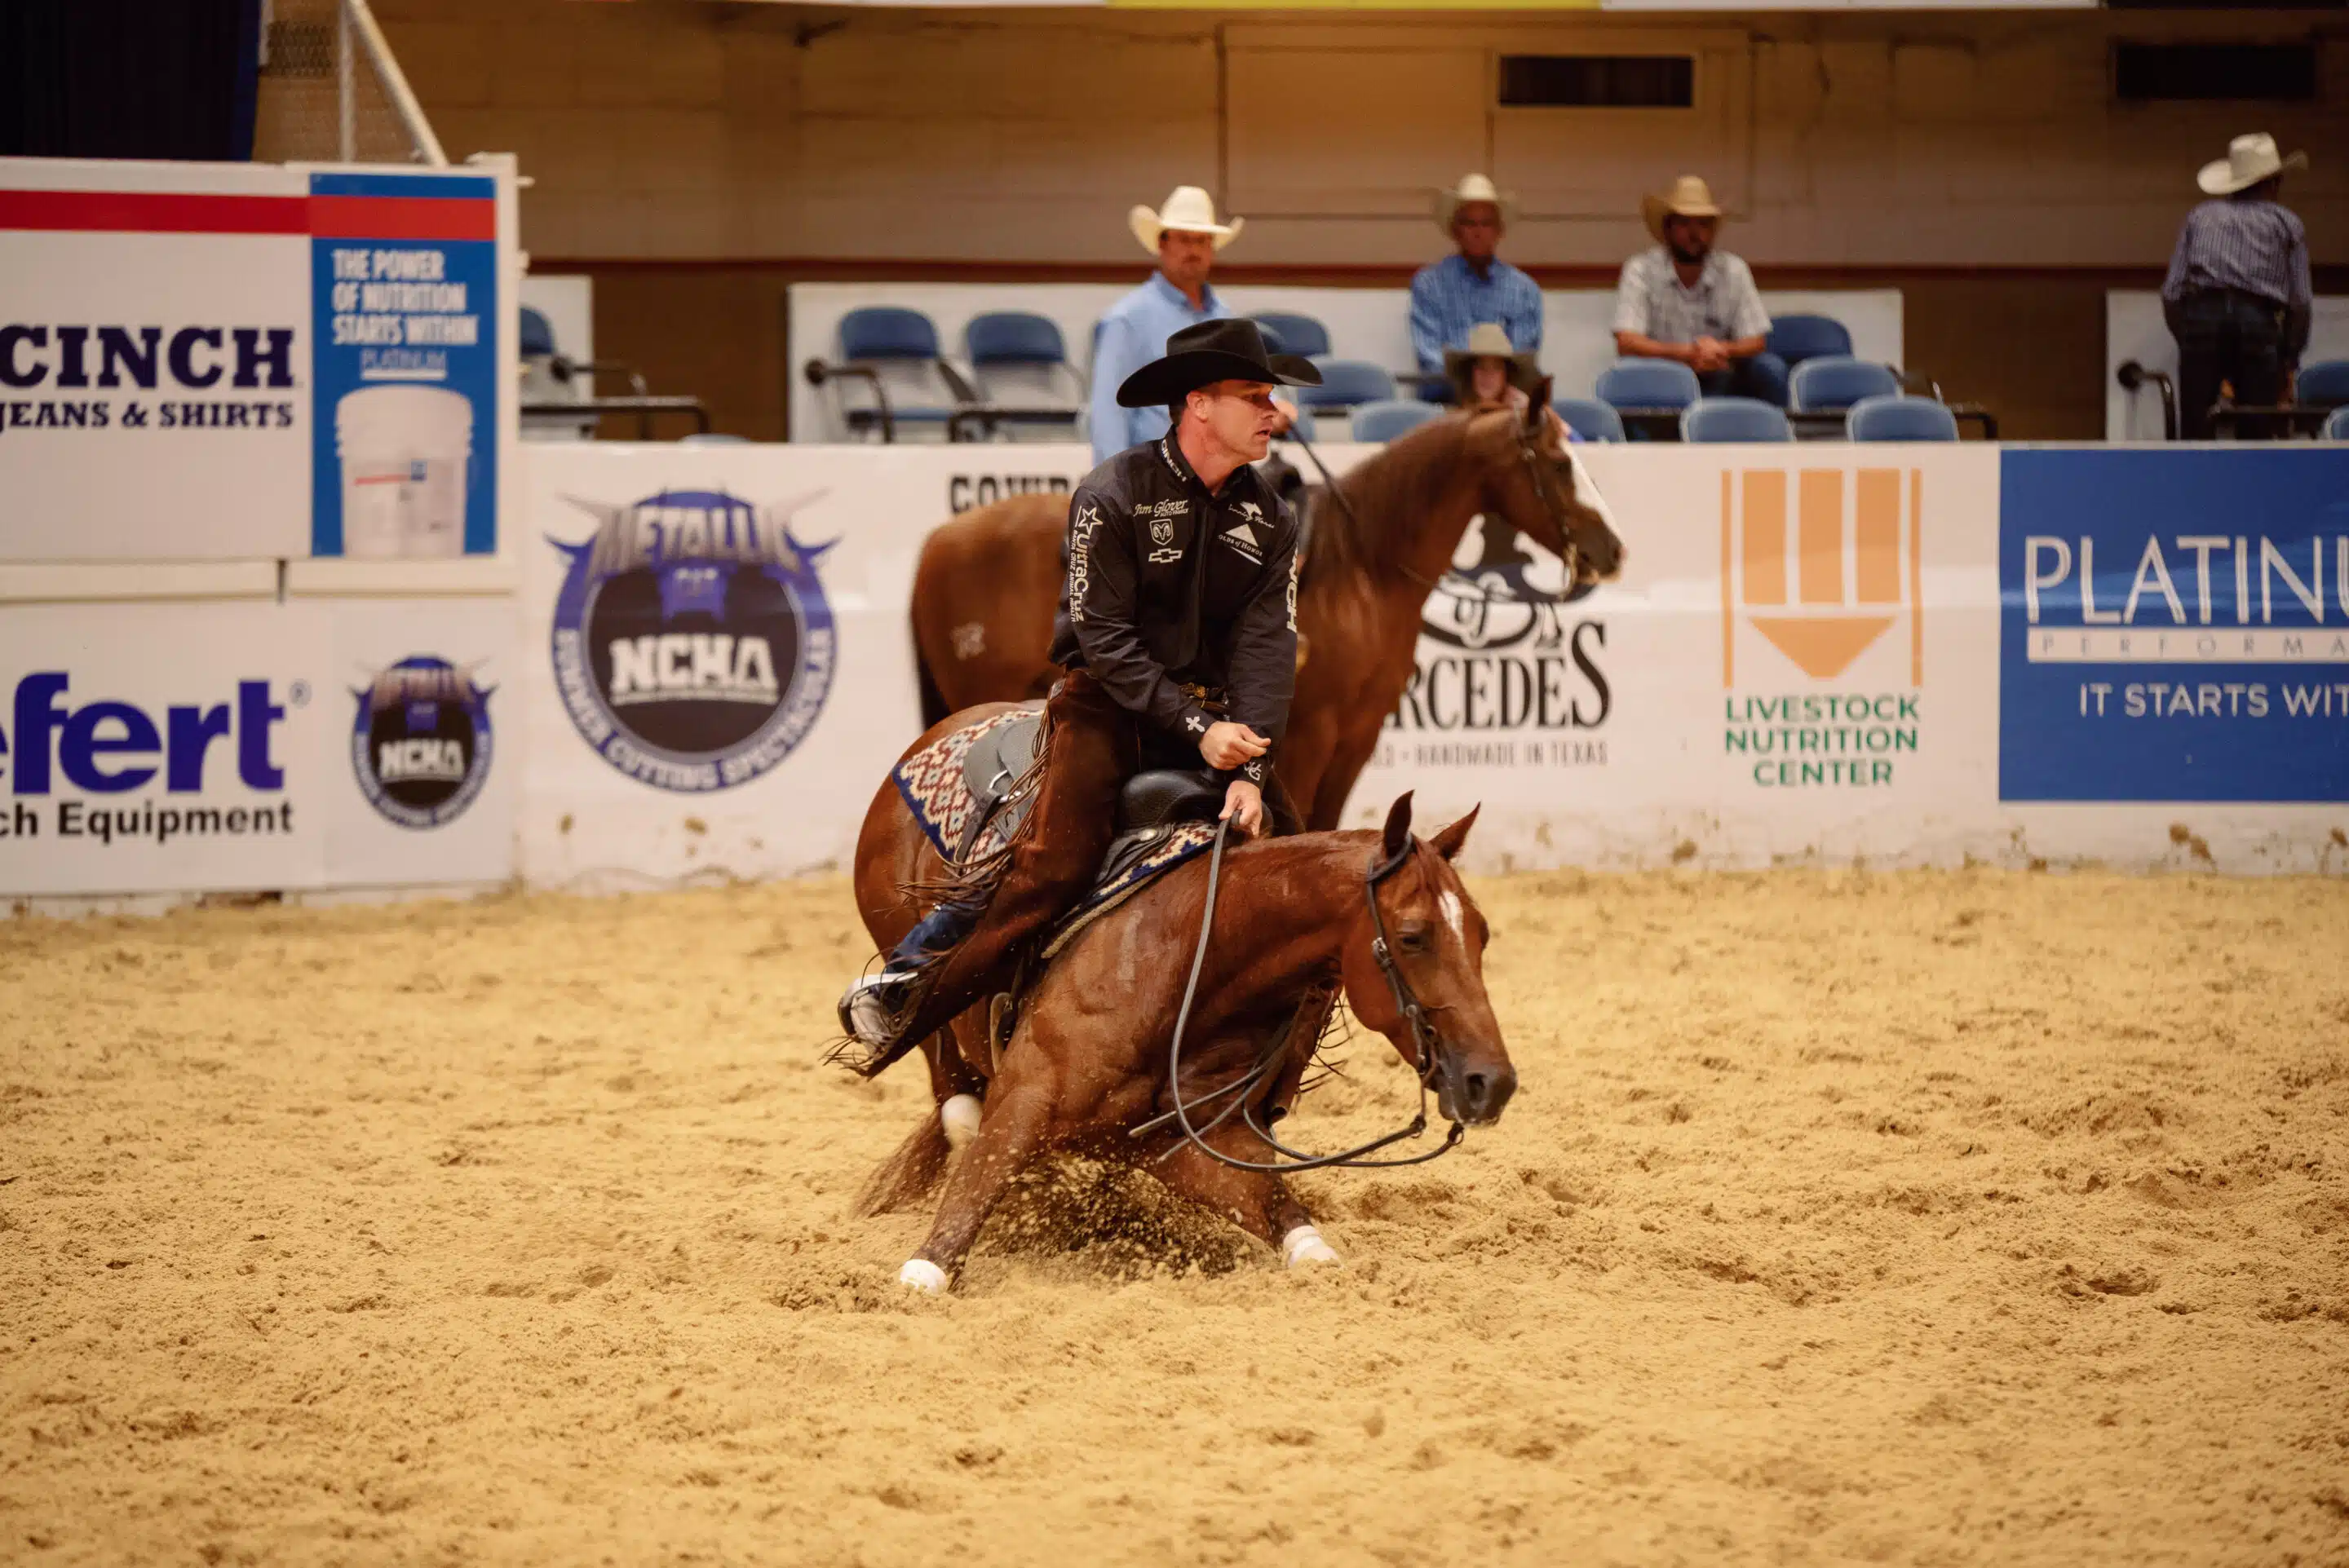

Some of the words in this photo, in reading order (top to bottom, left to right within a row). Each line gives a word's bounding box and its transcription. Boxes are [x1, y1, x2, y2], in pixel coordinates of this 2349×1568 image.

[0, 324, 294, 390] CINCH
[121, 403, 148, 428] &
[160, 403, 295, 429] SHIRTS
[1154, 498, 1188, 517] Glover
[1074, 532, 1090, 622] UltraCruz
[2025, 533, 2349, 625] PLATIN
[608, 632, 778, 697] NCHA
[1387, 621, 1611, 729] RCEDES
[1725, 695, 1920, 722] LIVESTOCK
[2081, 683, 2113, 718] IT
[2124, 683, 2269, 718] STARTS
[1526, 741, 1545, 766] IN
[1552, 740, 1608, 766] TEXAS
[1725, 727, 1918, 753] NUTRITION
[1754, 760, 1893, 786] CENTER
[57, 797, 294, 847] Equipment
